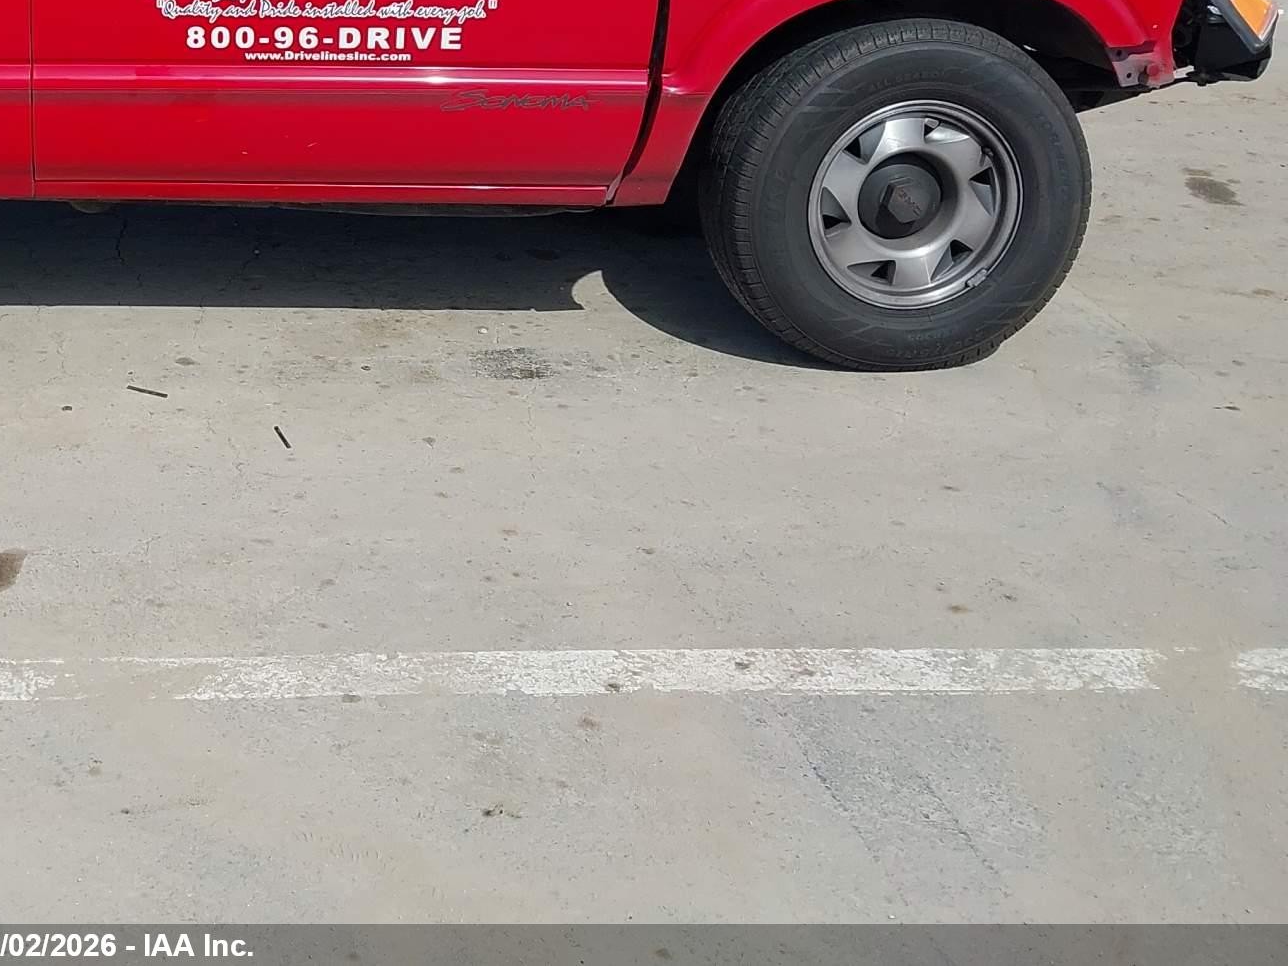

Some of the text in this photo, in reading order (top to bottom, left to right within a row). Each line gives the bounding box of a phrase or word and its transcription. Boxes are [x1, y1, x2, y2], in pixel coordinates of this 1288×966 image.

[222, 0, 257, 18] and
[302, 0, 376, 19] installed
[376, 0, 414, 19] with
[414, 7, 458, 25] every
[186, 26, 462, 50] 800-96-DRIVE
[244, 50, 411, 62] www.DrivelinesInc.com
